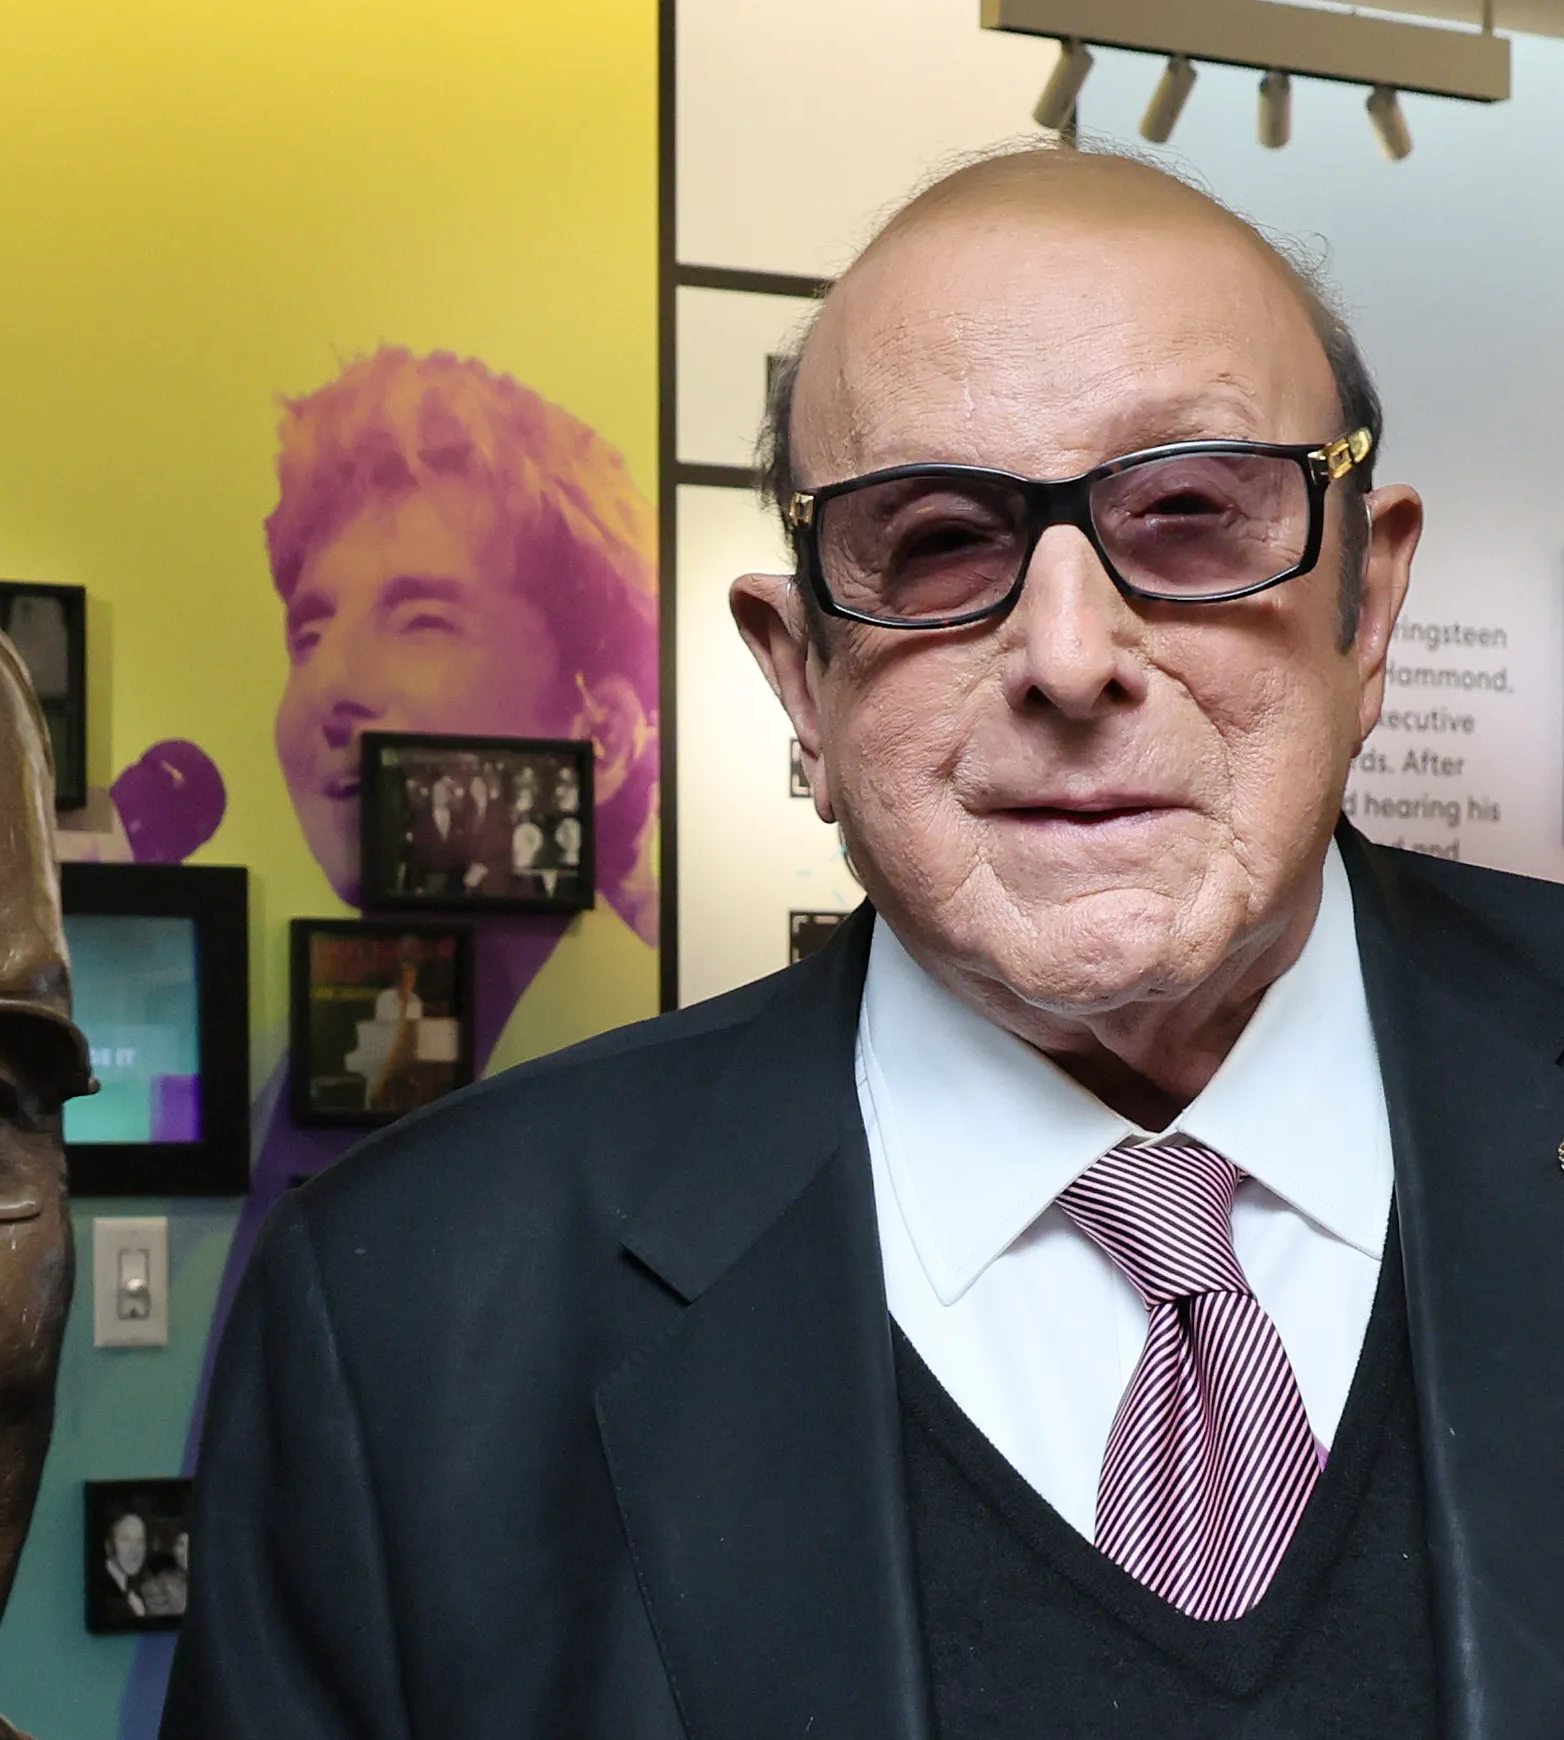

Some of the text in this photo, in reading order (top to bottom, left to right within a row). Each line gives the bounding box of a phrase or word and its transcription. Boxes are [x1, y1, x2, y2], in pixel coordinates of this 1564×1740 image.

[1393, 618, 1507, 652] ringsteen
[1379, 708, 1476, 734] ecutive
[1401, 749, 1465, 776] After
[1364, 794, 1462, 828] hearing
[1468, 797, 1501, 822] his
